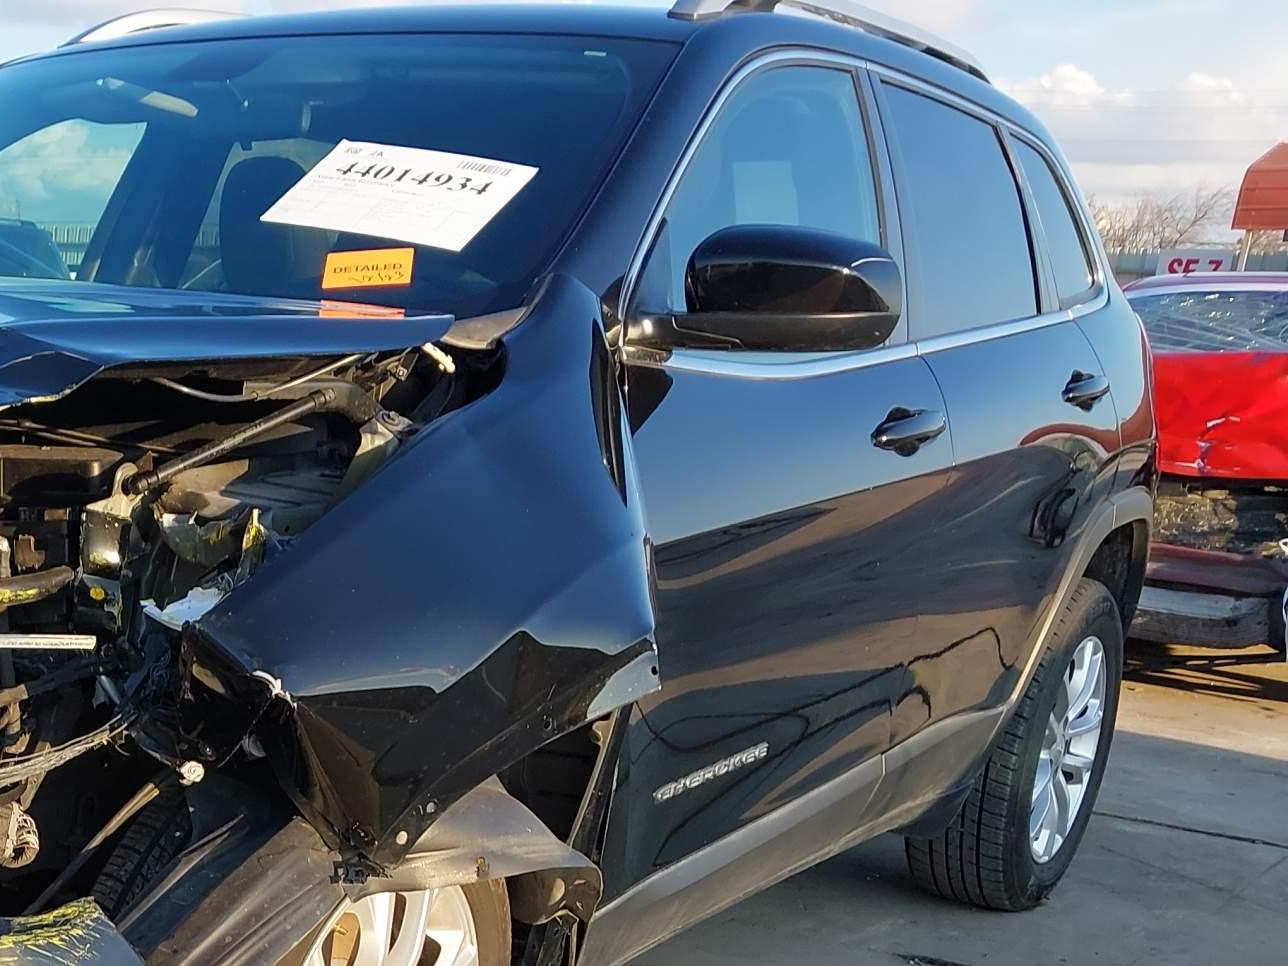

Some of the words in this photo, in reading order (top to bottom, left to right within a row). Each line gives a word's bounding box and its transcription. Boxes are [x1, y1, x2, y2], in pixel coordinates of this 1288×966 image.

[336, 161, 494, 196] 44014934
[332, 263, 403, 274] DETAILED
[652, 741, 769, 805] CHEROKEE
